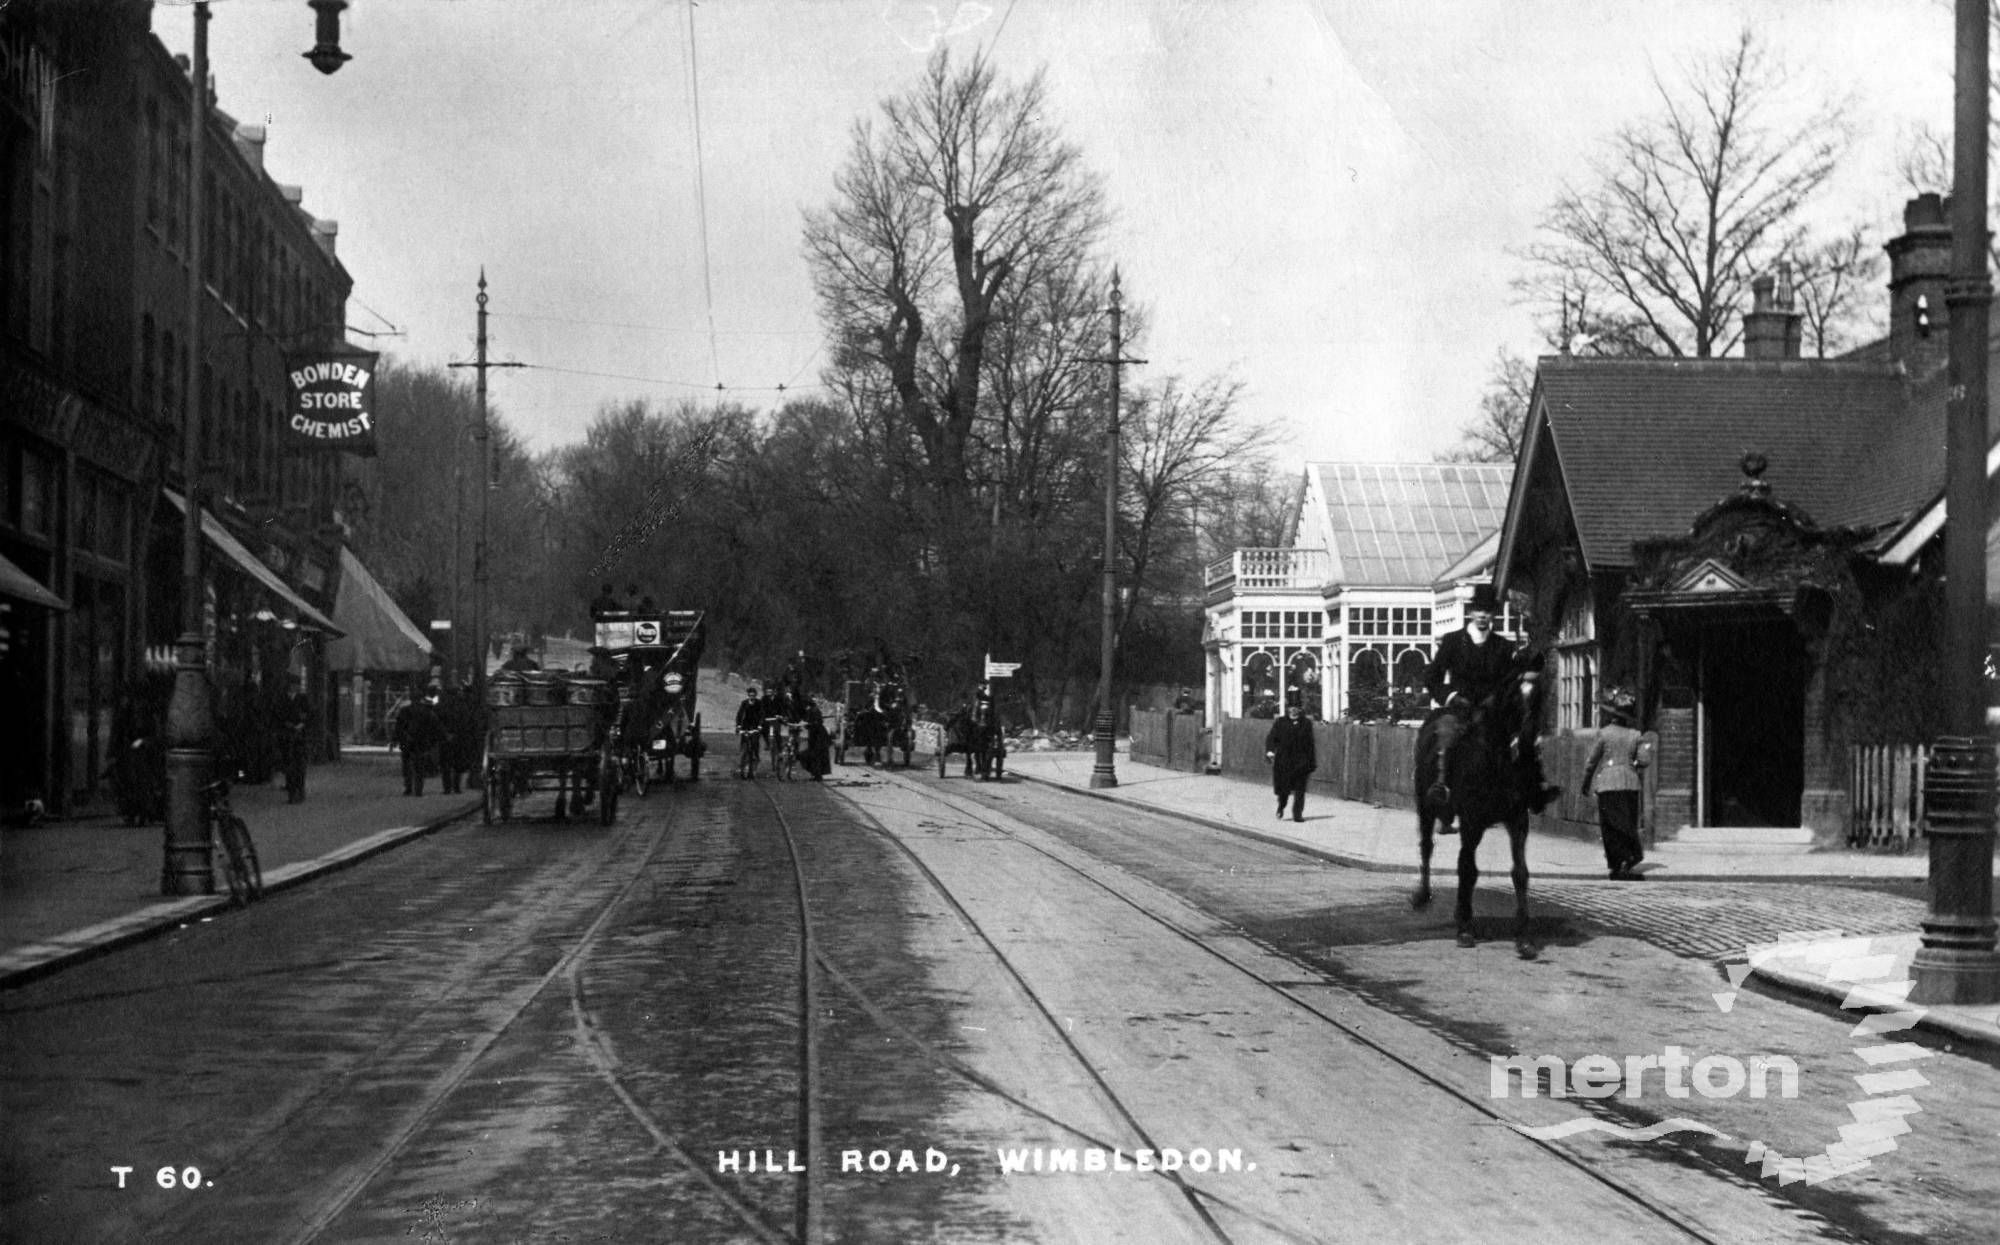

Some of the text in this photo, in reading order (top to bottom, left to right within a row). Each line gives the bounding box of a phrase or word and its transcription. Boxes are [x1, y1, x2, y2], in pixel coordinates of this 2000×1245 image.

[291, 362, 370, 389] BOWDEN
[301, 391, 362, 409] STORE
[291, 412, 371, 438] CHEMIST
